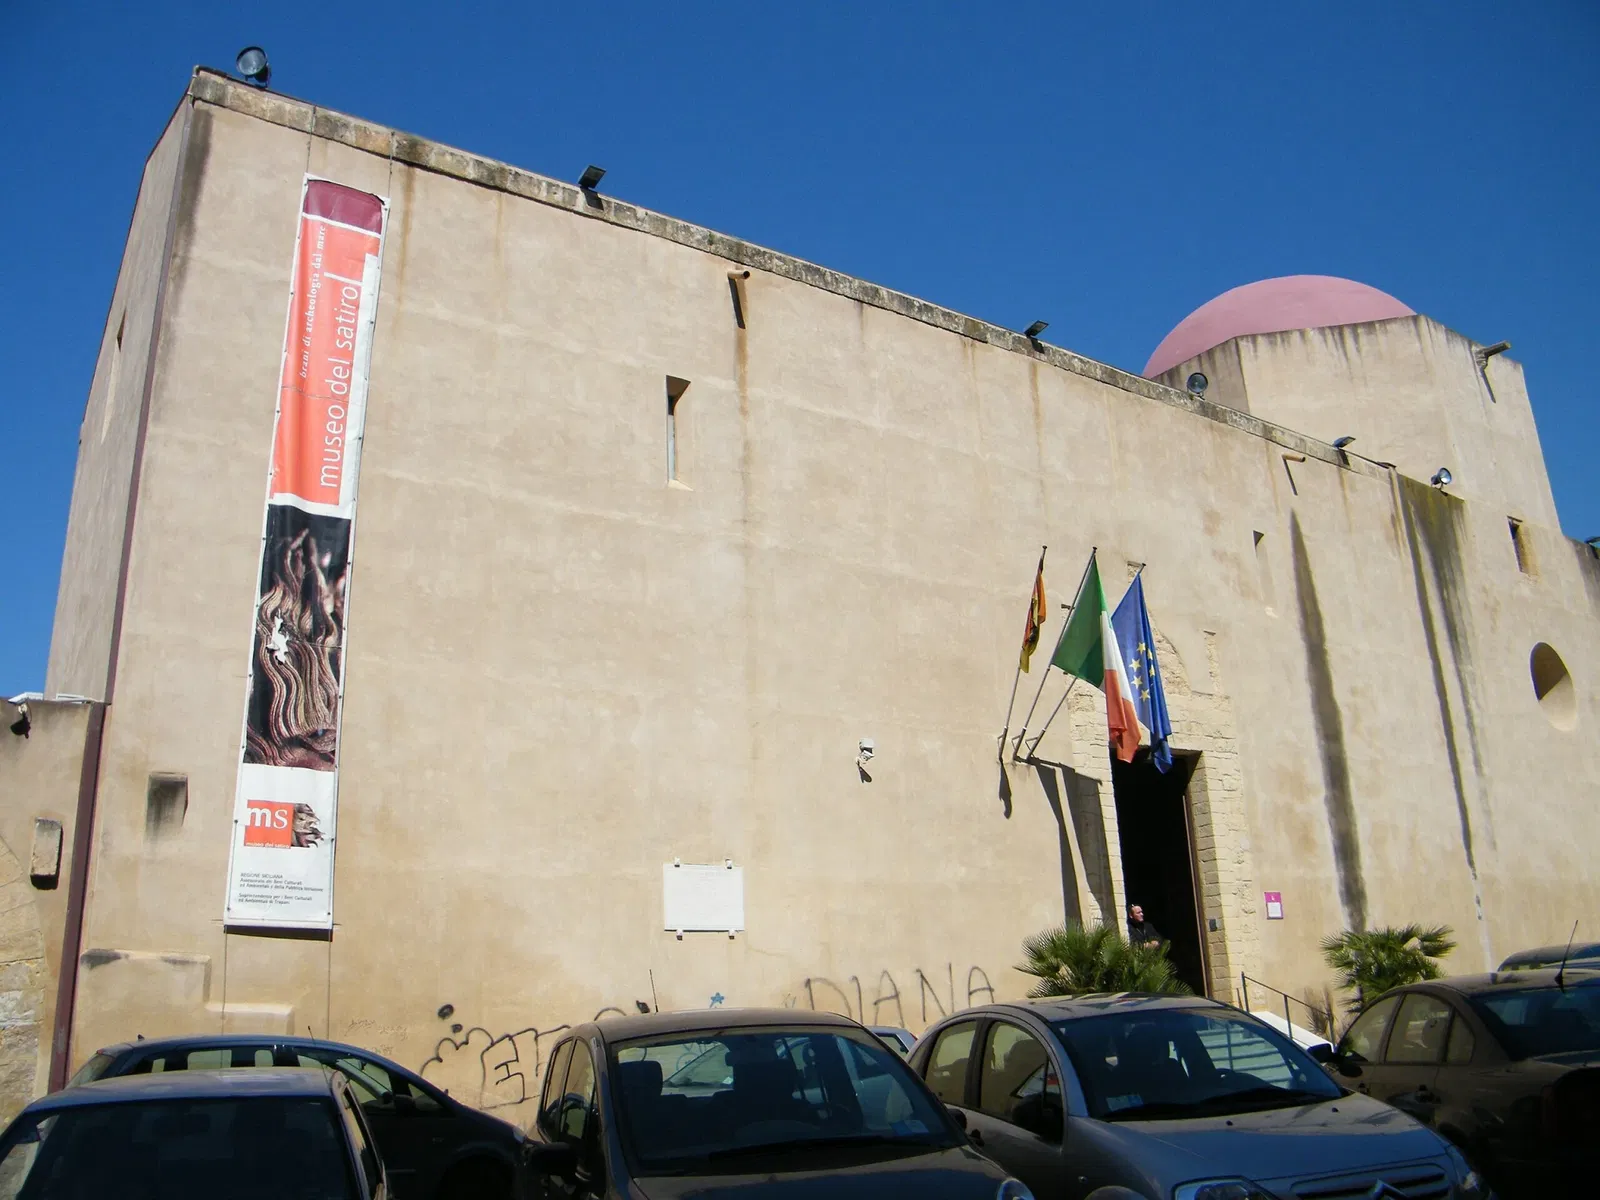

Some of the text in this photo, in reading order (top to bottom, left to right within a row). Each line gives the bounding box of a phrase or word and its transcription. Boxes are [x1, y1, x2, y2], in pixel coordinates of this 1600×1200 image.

[317, 225, 326, 250] mare
[312, 252, 322, 268] dal
[304, 273, 322, 333] archeologia
[302, 336, 312, 346] di
[320, 286, 358, 488] museo del satiro
[245, 807, 288, 829] ms
[805, 962, 995, 1028] DIANA
